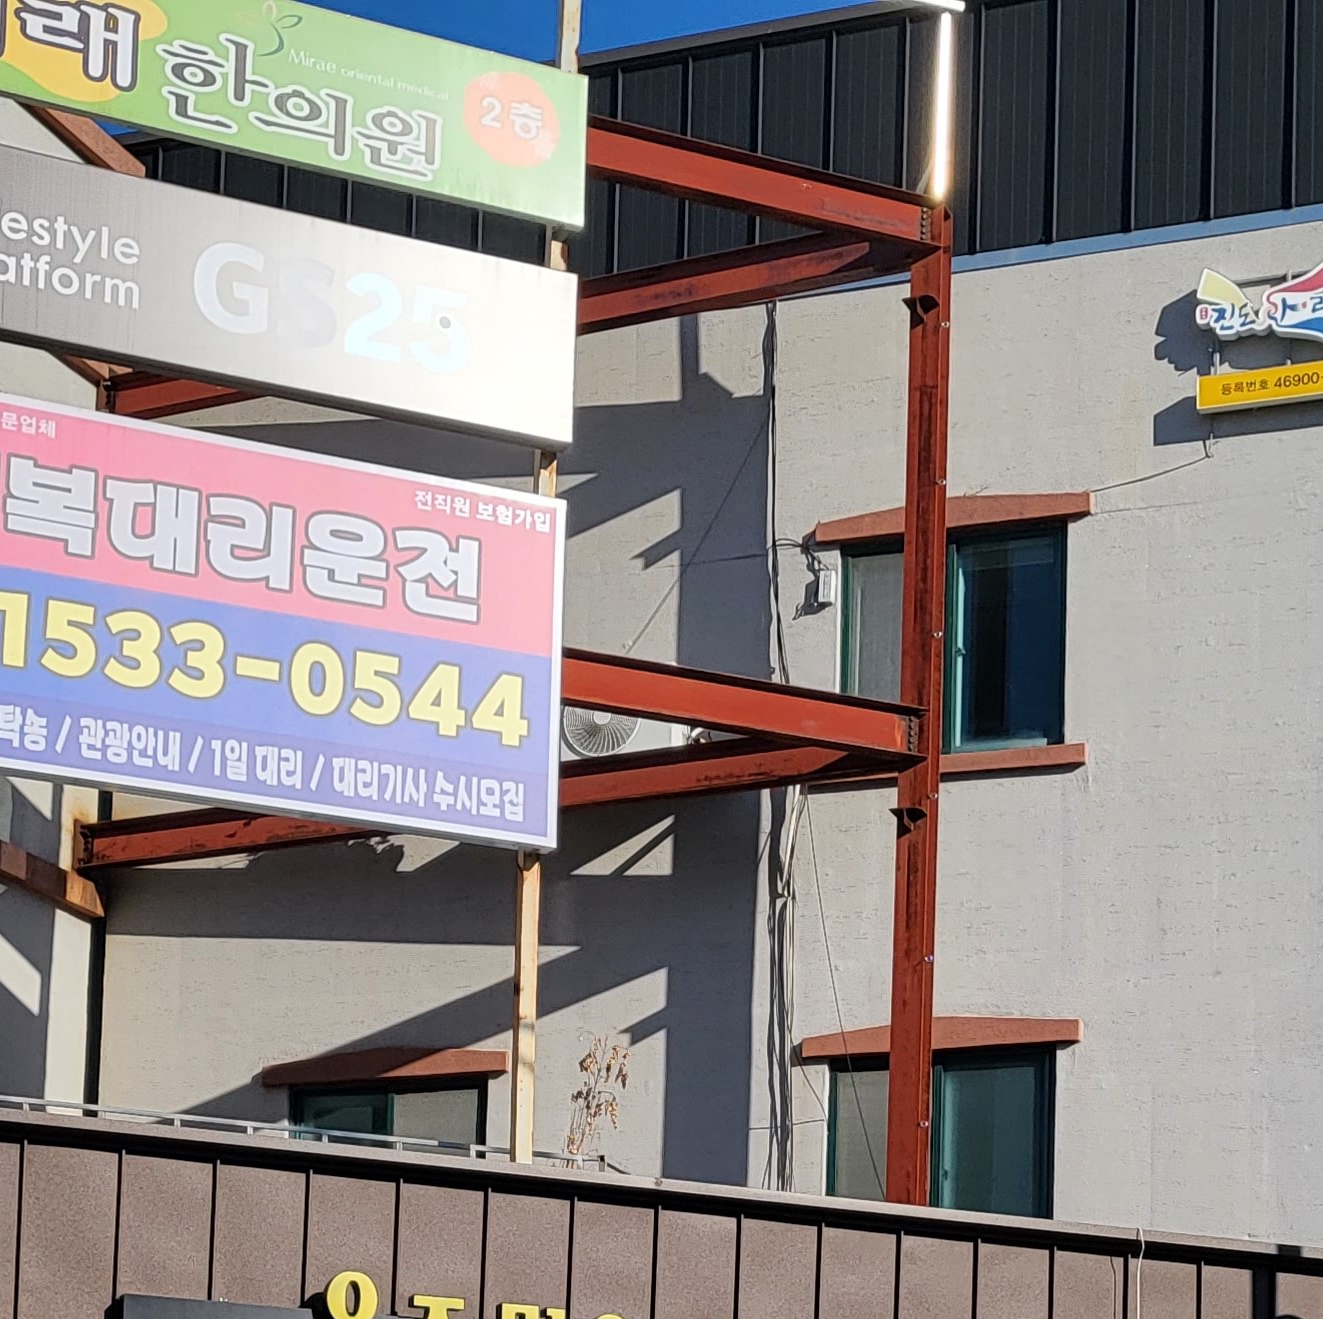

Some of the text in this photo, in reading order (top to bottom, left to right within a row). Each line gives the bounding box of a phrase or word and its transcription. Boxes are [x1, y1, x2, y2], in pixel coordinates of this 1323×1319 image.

[288, 49, 450, 101] Mirae oriental medical
[156, 33, 442, 181] 한의원
[481, 96, 543, 141] 2층
[193, 240, 470, 375] GS25
[1220, 378, 1270, 396] 등록번호
[415, 489, 552, 533] 전직원 보험가입
[78, 717, 182, 772] 관광안내
[211, 737, 248, 783] 1일
[255, 747, 304, 790] 대리
[332, 755, 428, 808] 대리기사
[433, 775, 526, 822] 수시모집
